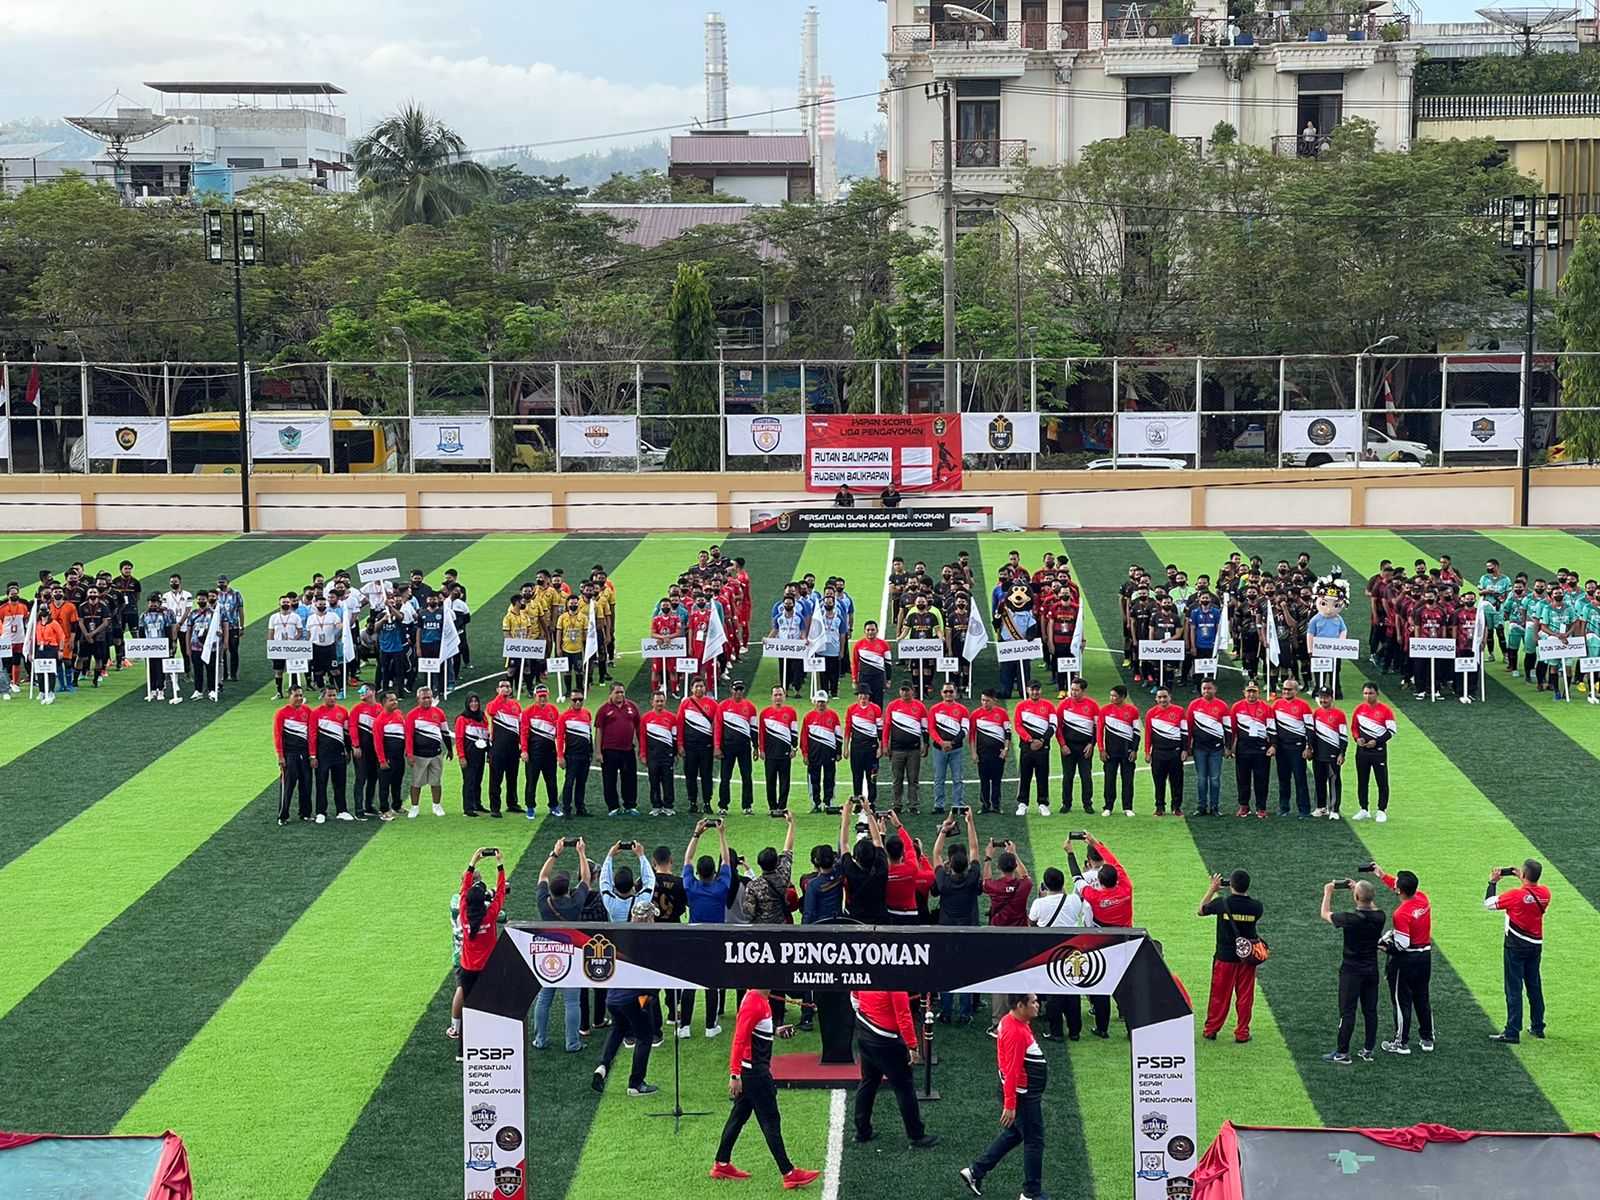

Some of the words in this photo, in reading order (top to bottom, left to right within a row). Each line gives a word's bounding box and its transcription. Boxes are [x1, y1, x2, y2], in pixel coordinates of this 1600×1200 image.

[840, 428, 859, 436] LIGA
[861, 428, 923, 436] PENGAYOMAN
[815, 452, 840, 462] RUTAN
[842, 452, 889, 462] BALIKPAPAN
[814, 472, 846, 481] RUDENIM
[847, 471, 889, 481] BALIKPAPAN
[531, 943, 574, 954] PENGAYOMAN
[724, 942, 775, 964] LIGA
[780, 942, 930, 965] PENGAYOMAN
[841, 972, 872, 985] TARA
[467, 1048, 515, 1060] PSBP
[1137, 1056, 1186, 1068] PSBP
